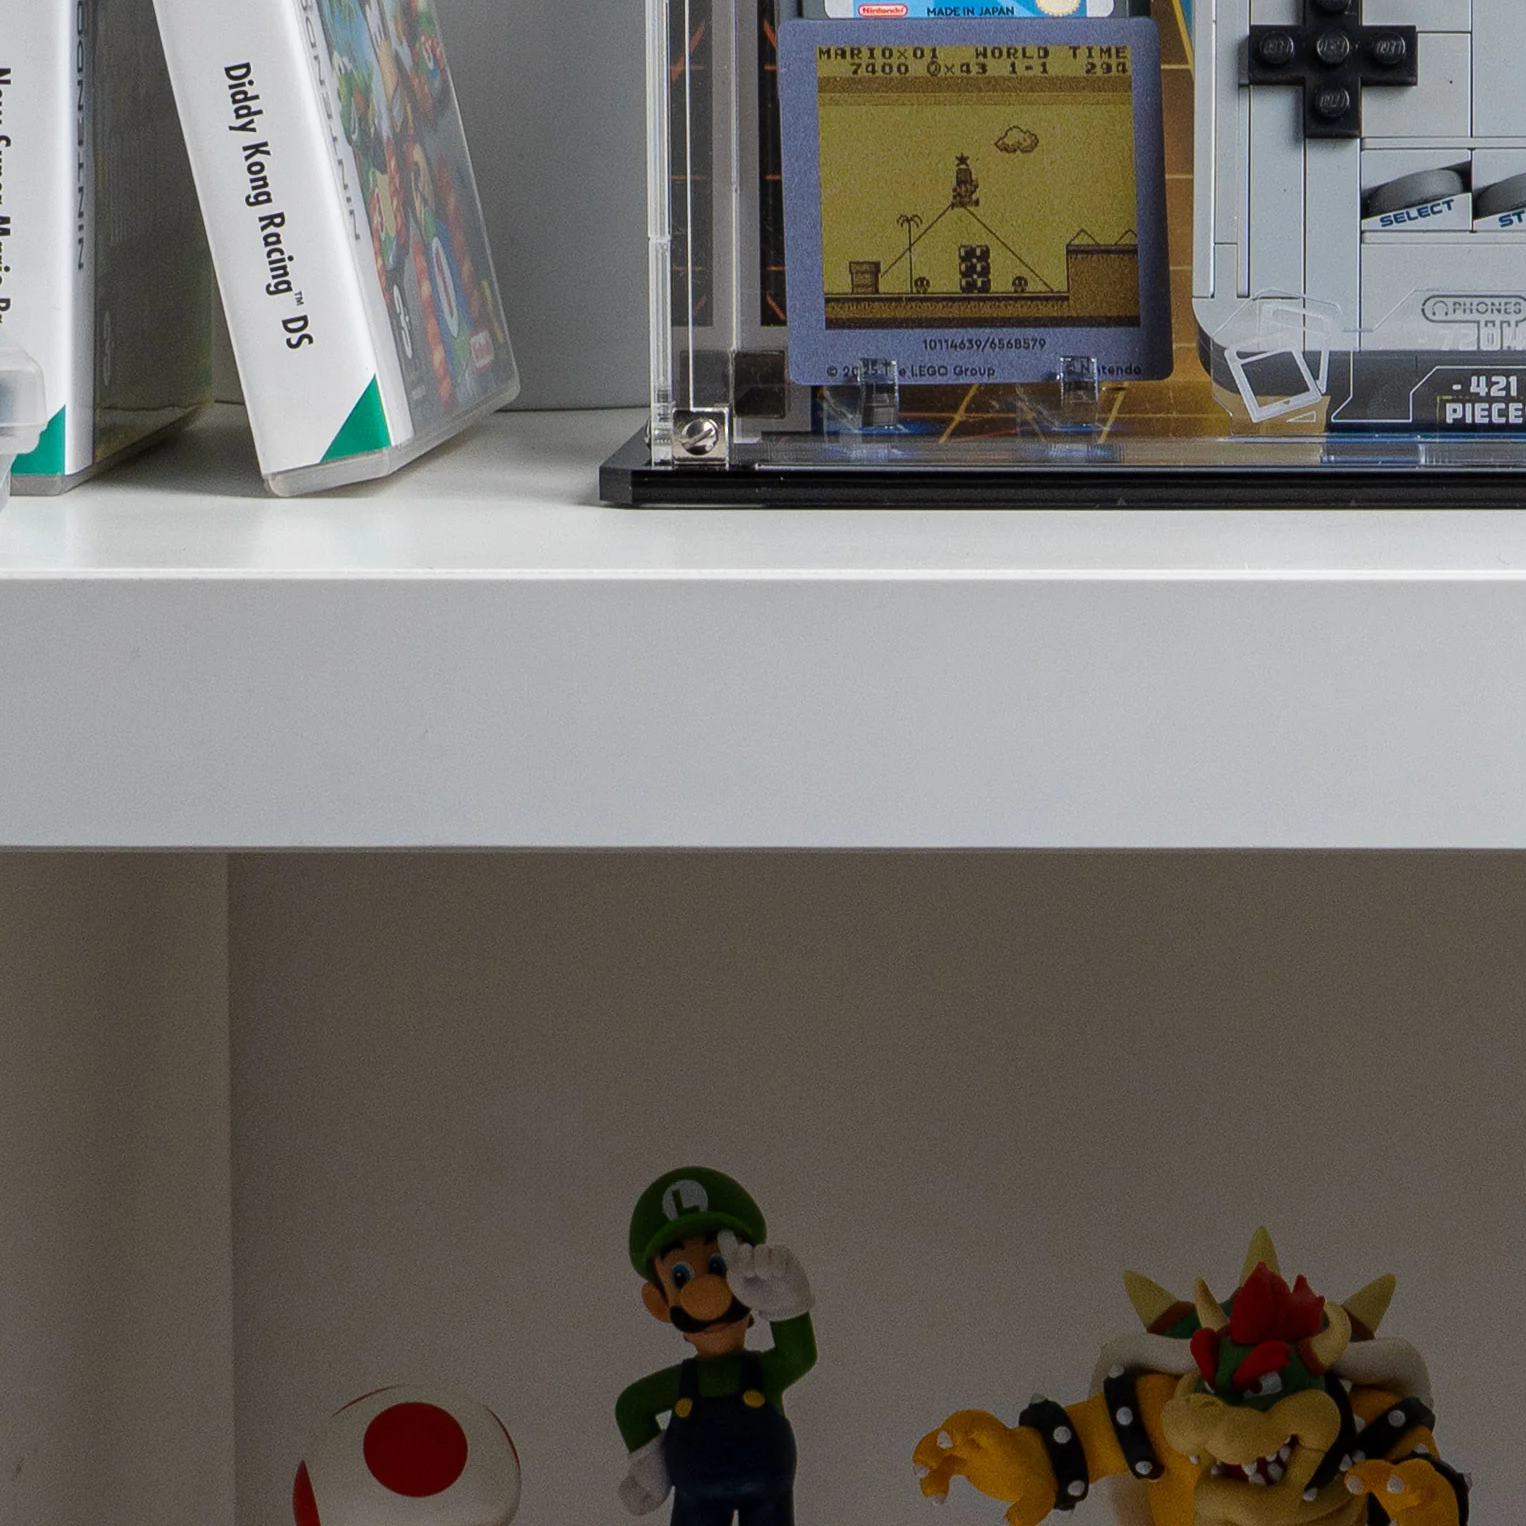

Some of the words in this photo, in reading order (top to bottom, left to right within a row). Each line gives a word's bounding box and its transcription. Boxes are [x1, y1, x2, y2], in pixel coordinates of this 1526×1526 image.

[927, 7, 961, 17] MADE
[963, 7, 975, 16] IN
[979, 6, 1015, 16] JAPAN
[974, 46, 1050, 60] WORLD
[1067, 45, 1129, 59] TIME
[223, 61, 264, 135] Diddy
[242, 140, 274, 208] Kong
[1379, 198, 1456, 228] SELECT
[1452, 300, 1522, 316] PHONES
[281, 314, 314, 350] DS
[911, 365, 949, 377] LEGO
[953, 365, 996, 378] Group
[1469, 375, 1518, 397] 421
